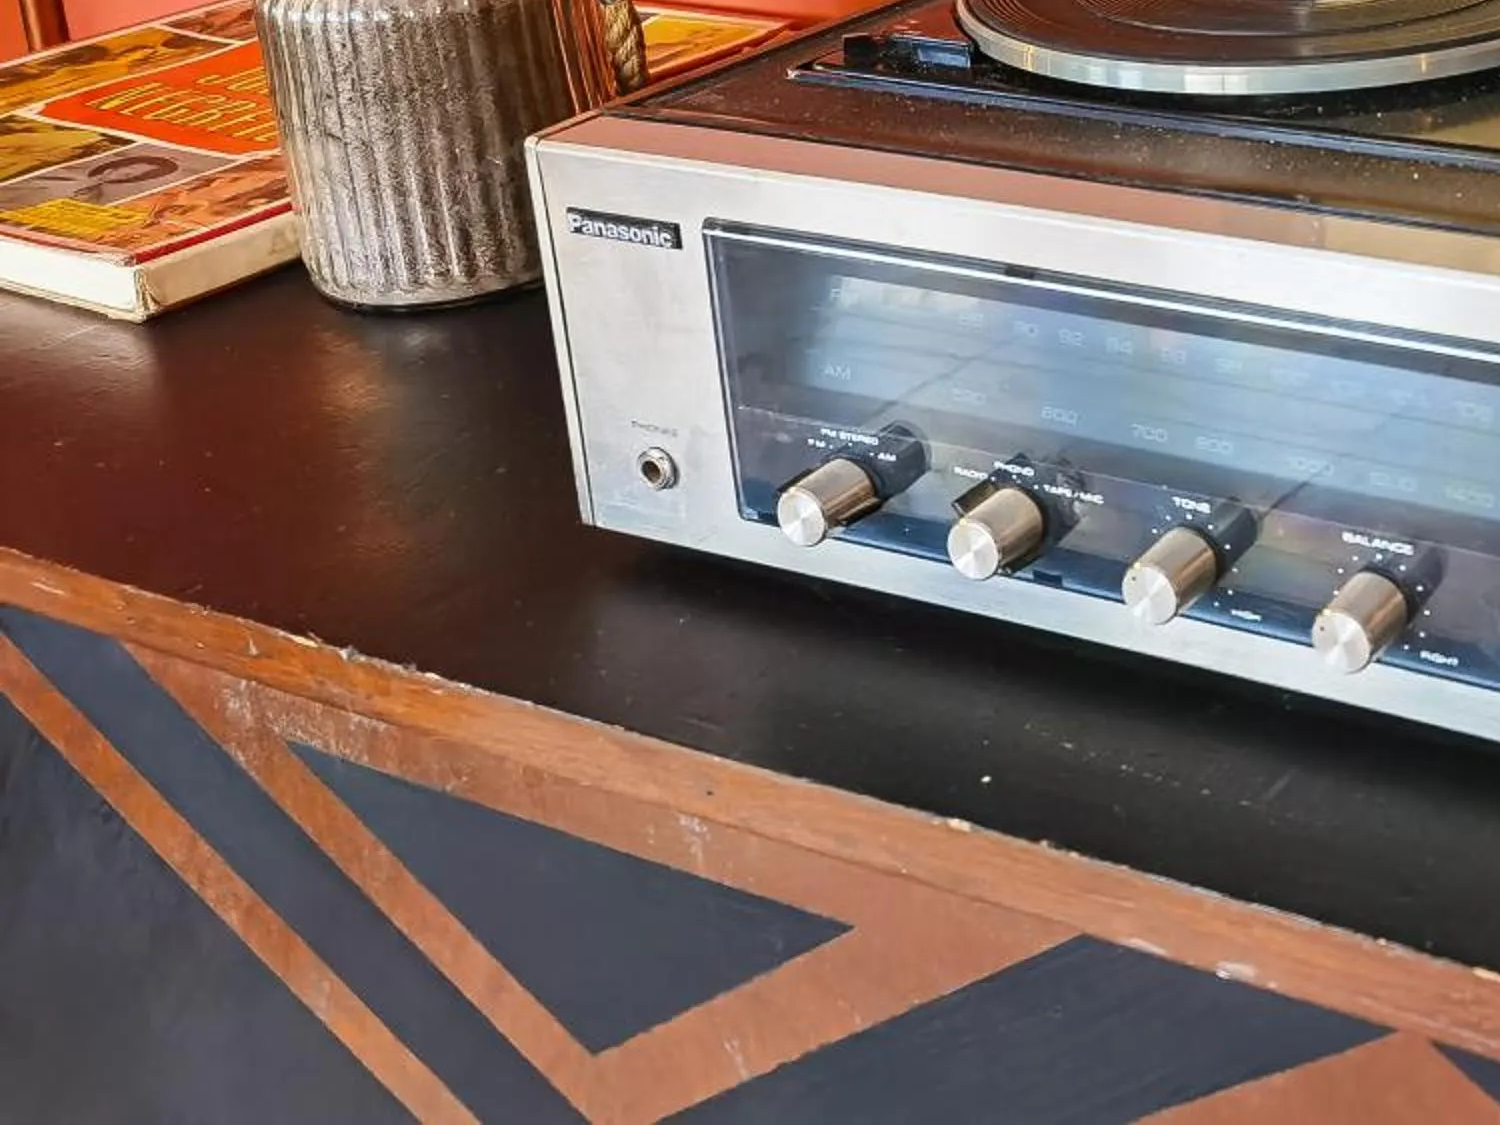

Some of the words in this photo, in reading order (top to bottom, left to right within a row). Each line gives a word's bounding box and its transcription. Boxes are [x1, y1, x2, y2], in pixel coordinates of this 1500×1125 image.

[567, 213, 674, 249] Panasonic
[824, 361, 851, 381] AM
[839, 429, 880, 446] STEREO
[1130, 422, 1169, 443] 700
[1171, 496, 1212, 514] TONE
[1340, 530, 1415, 556] BALANCE
